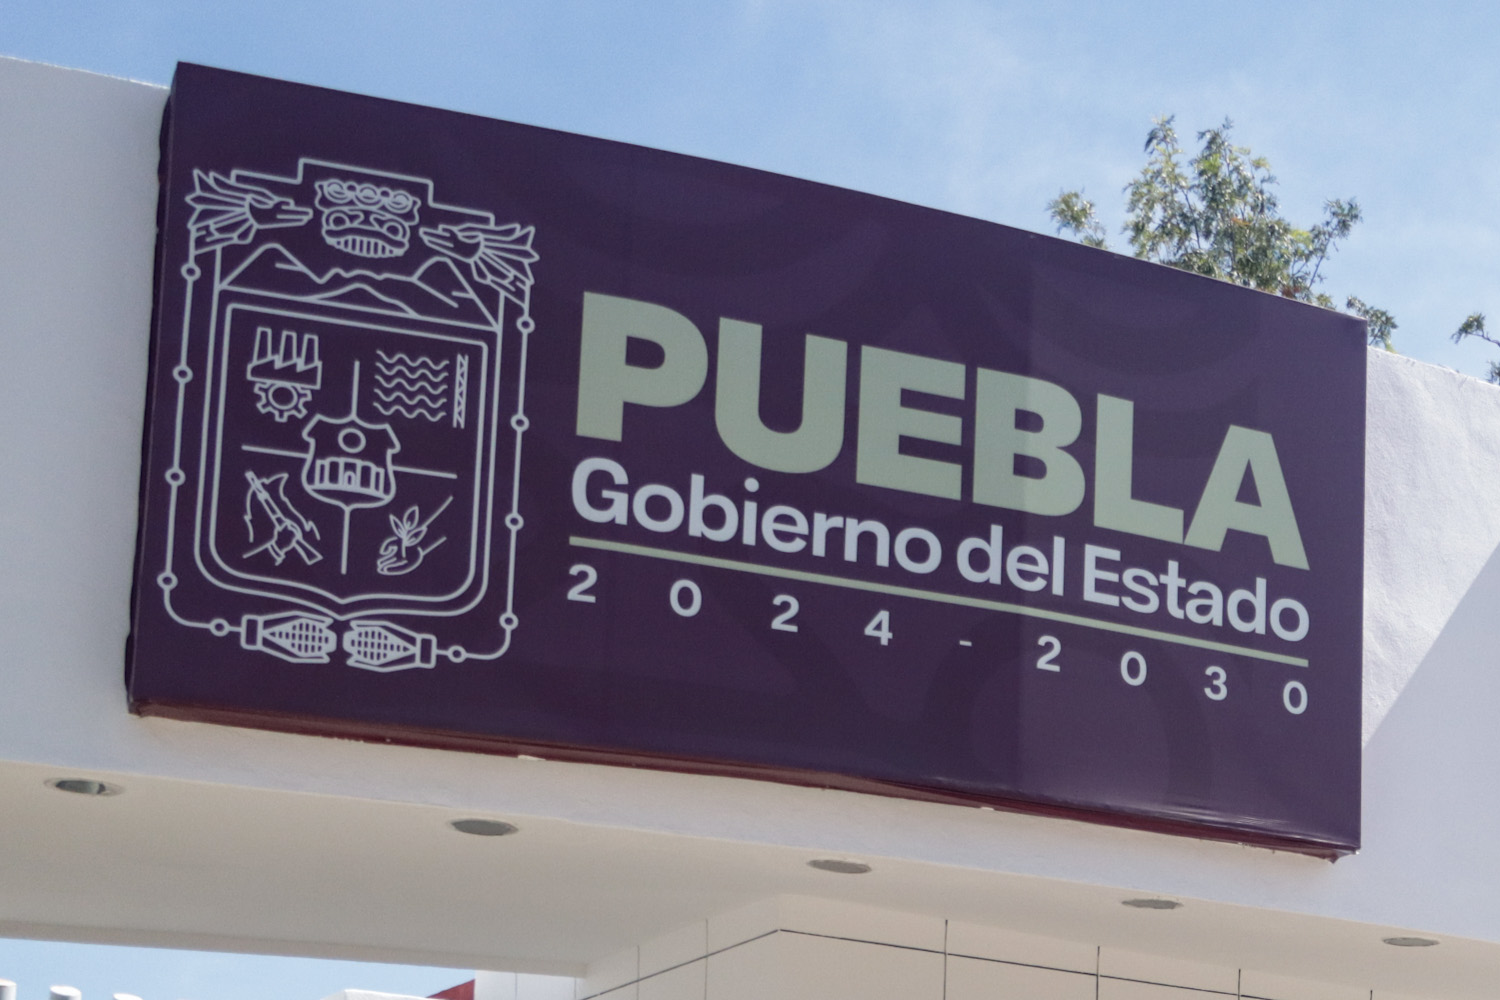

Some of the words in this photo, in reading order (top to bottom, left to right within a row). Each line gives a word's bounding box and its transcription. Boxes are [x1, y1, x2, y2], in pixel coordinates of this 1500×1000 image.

[576, 291, 1310, 571] PUEBLA
[571, 457, 942, 575] Gobierno
[956, 524, 1066, 597] del
[1083, 543, 1310, 642] Estado
